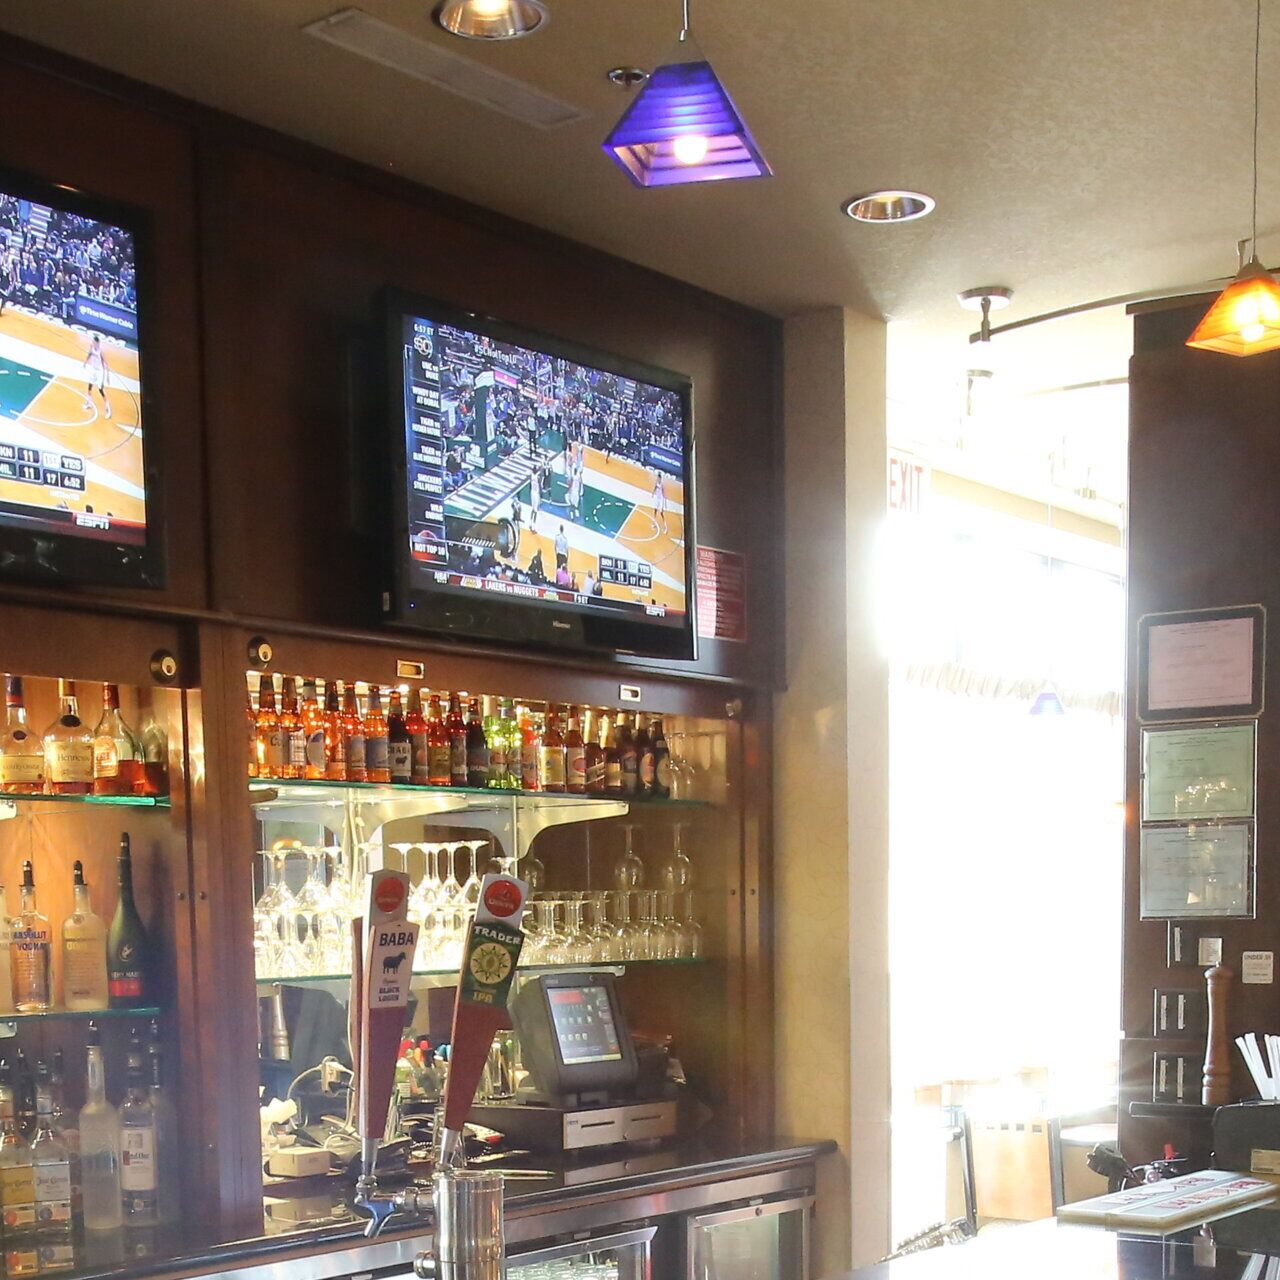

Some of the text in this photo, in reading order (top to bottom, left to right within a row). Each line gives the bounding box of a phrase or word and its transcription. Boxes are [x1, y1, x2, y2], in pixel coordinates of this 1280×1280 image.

[22, 449, 34, 462] 11
[62, 457, 81, 469] YES
[22, 467, 34, 479] 11
[46, 472, 56, 485] 17
[889, 458, 923, 513] EXIT
[76, 516, 110, 530] ESPN
[485, 582, 507, 592] LAKERS
[13, 931, 47, 940] ABSOLUT
[379, 932, 414, 947] BABA
[473, 925, 520, 945] TRADER
[472, 990, 493, 1003] IPA
